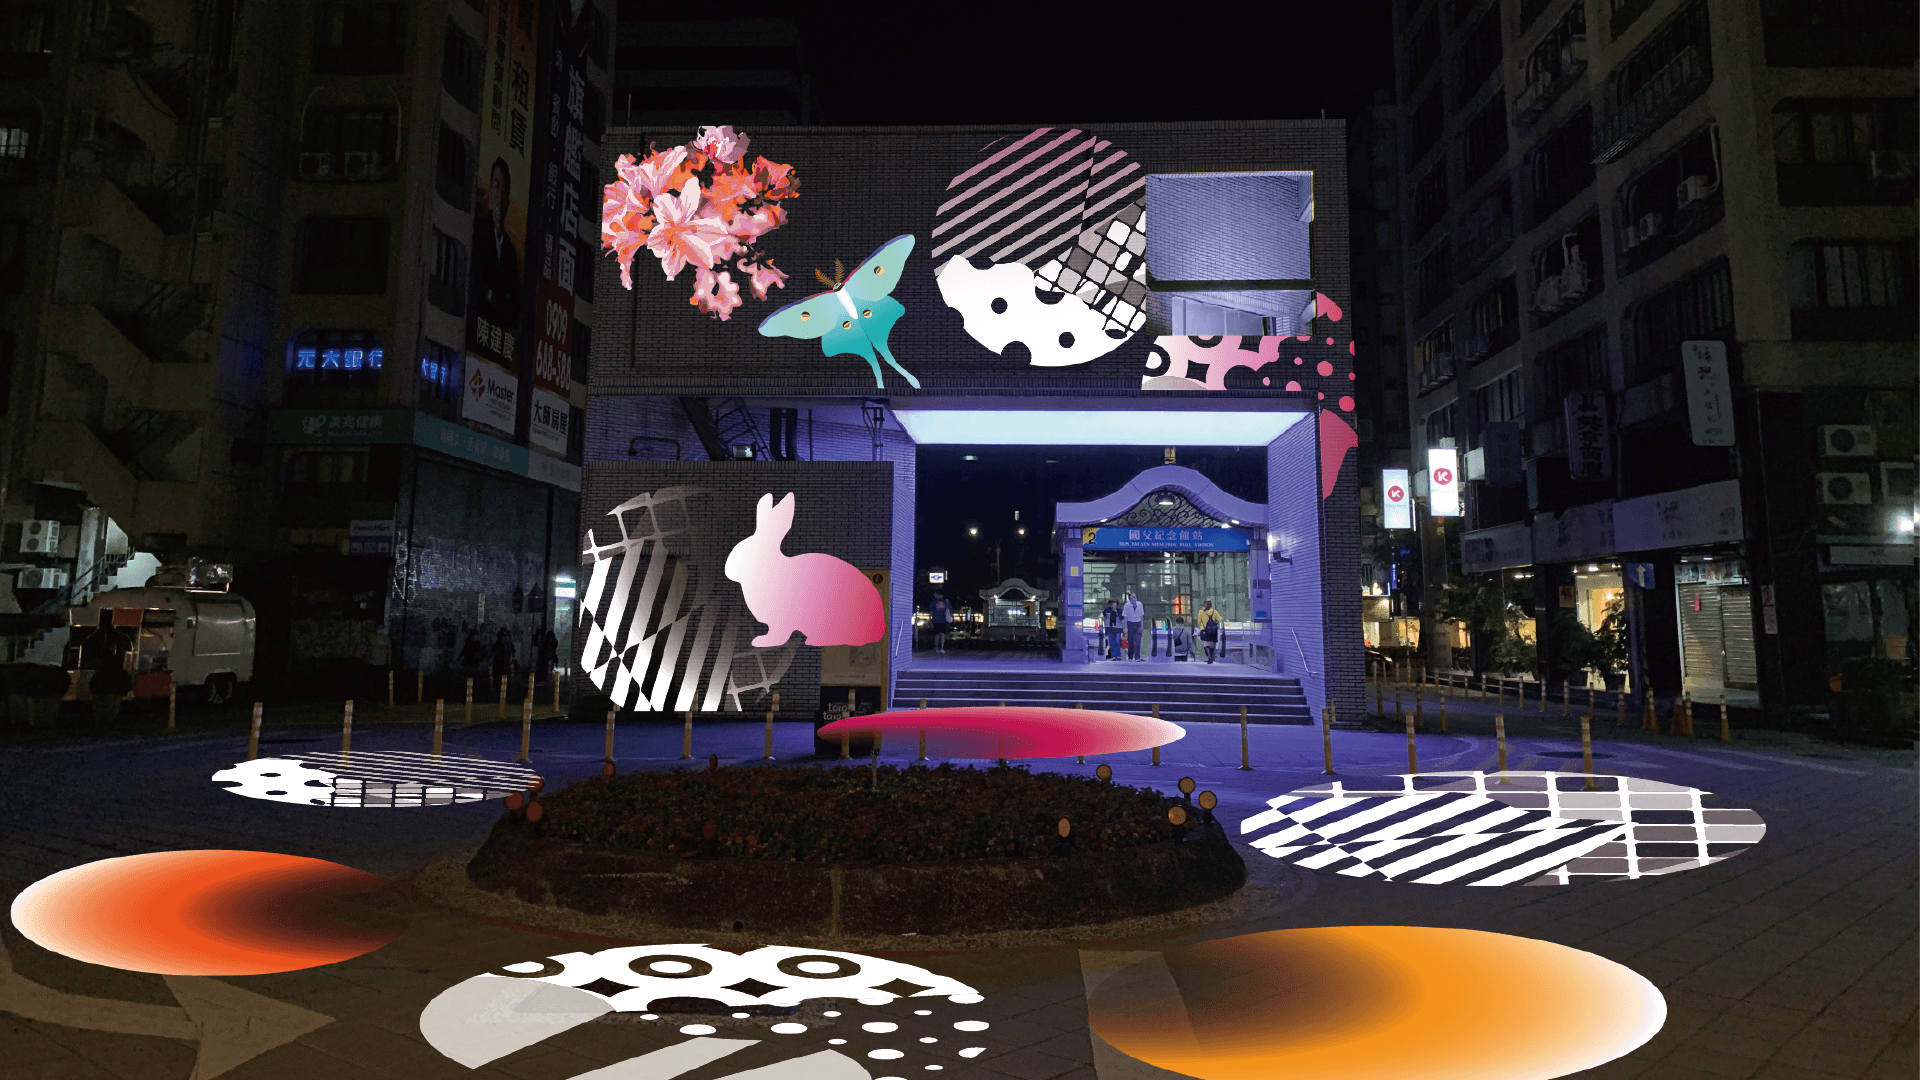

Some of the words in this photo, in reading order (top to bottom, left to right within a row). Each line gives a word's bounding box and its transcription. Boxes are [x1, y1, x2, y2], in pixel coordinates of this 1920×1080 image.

[558, 64, 586, 297] 旗艦店面
[477, 316, 515, 361] 陳建慶
[546, 299, 568, 345] 0909
[297, 348, 383, 369] 元大銀行
[536, 340, 571, 391] 688-588
[487, 378, 515, 403] Master
[534, 399, 568, 435] 大師房屋
[1088, 532, 1096, 545] 2
[1129, 530, 1203, 541] 國父紀念館站
